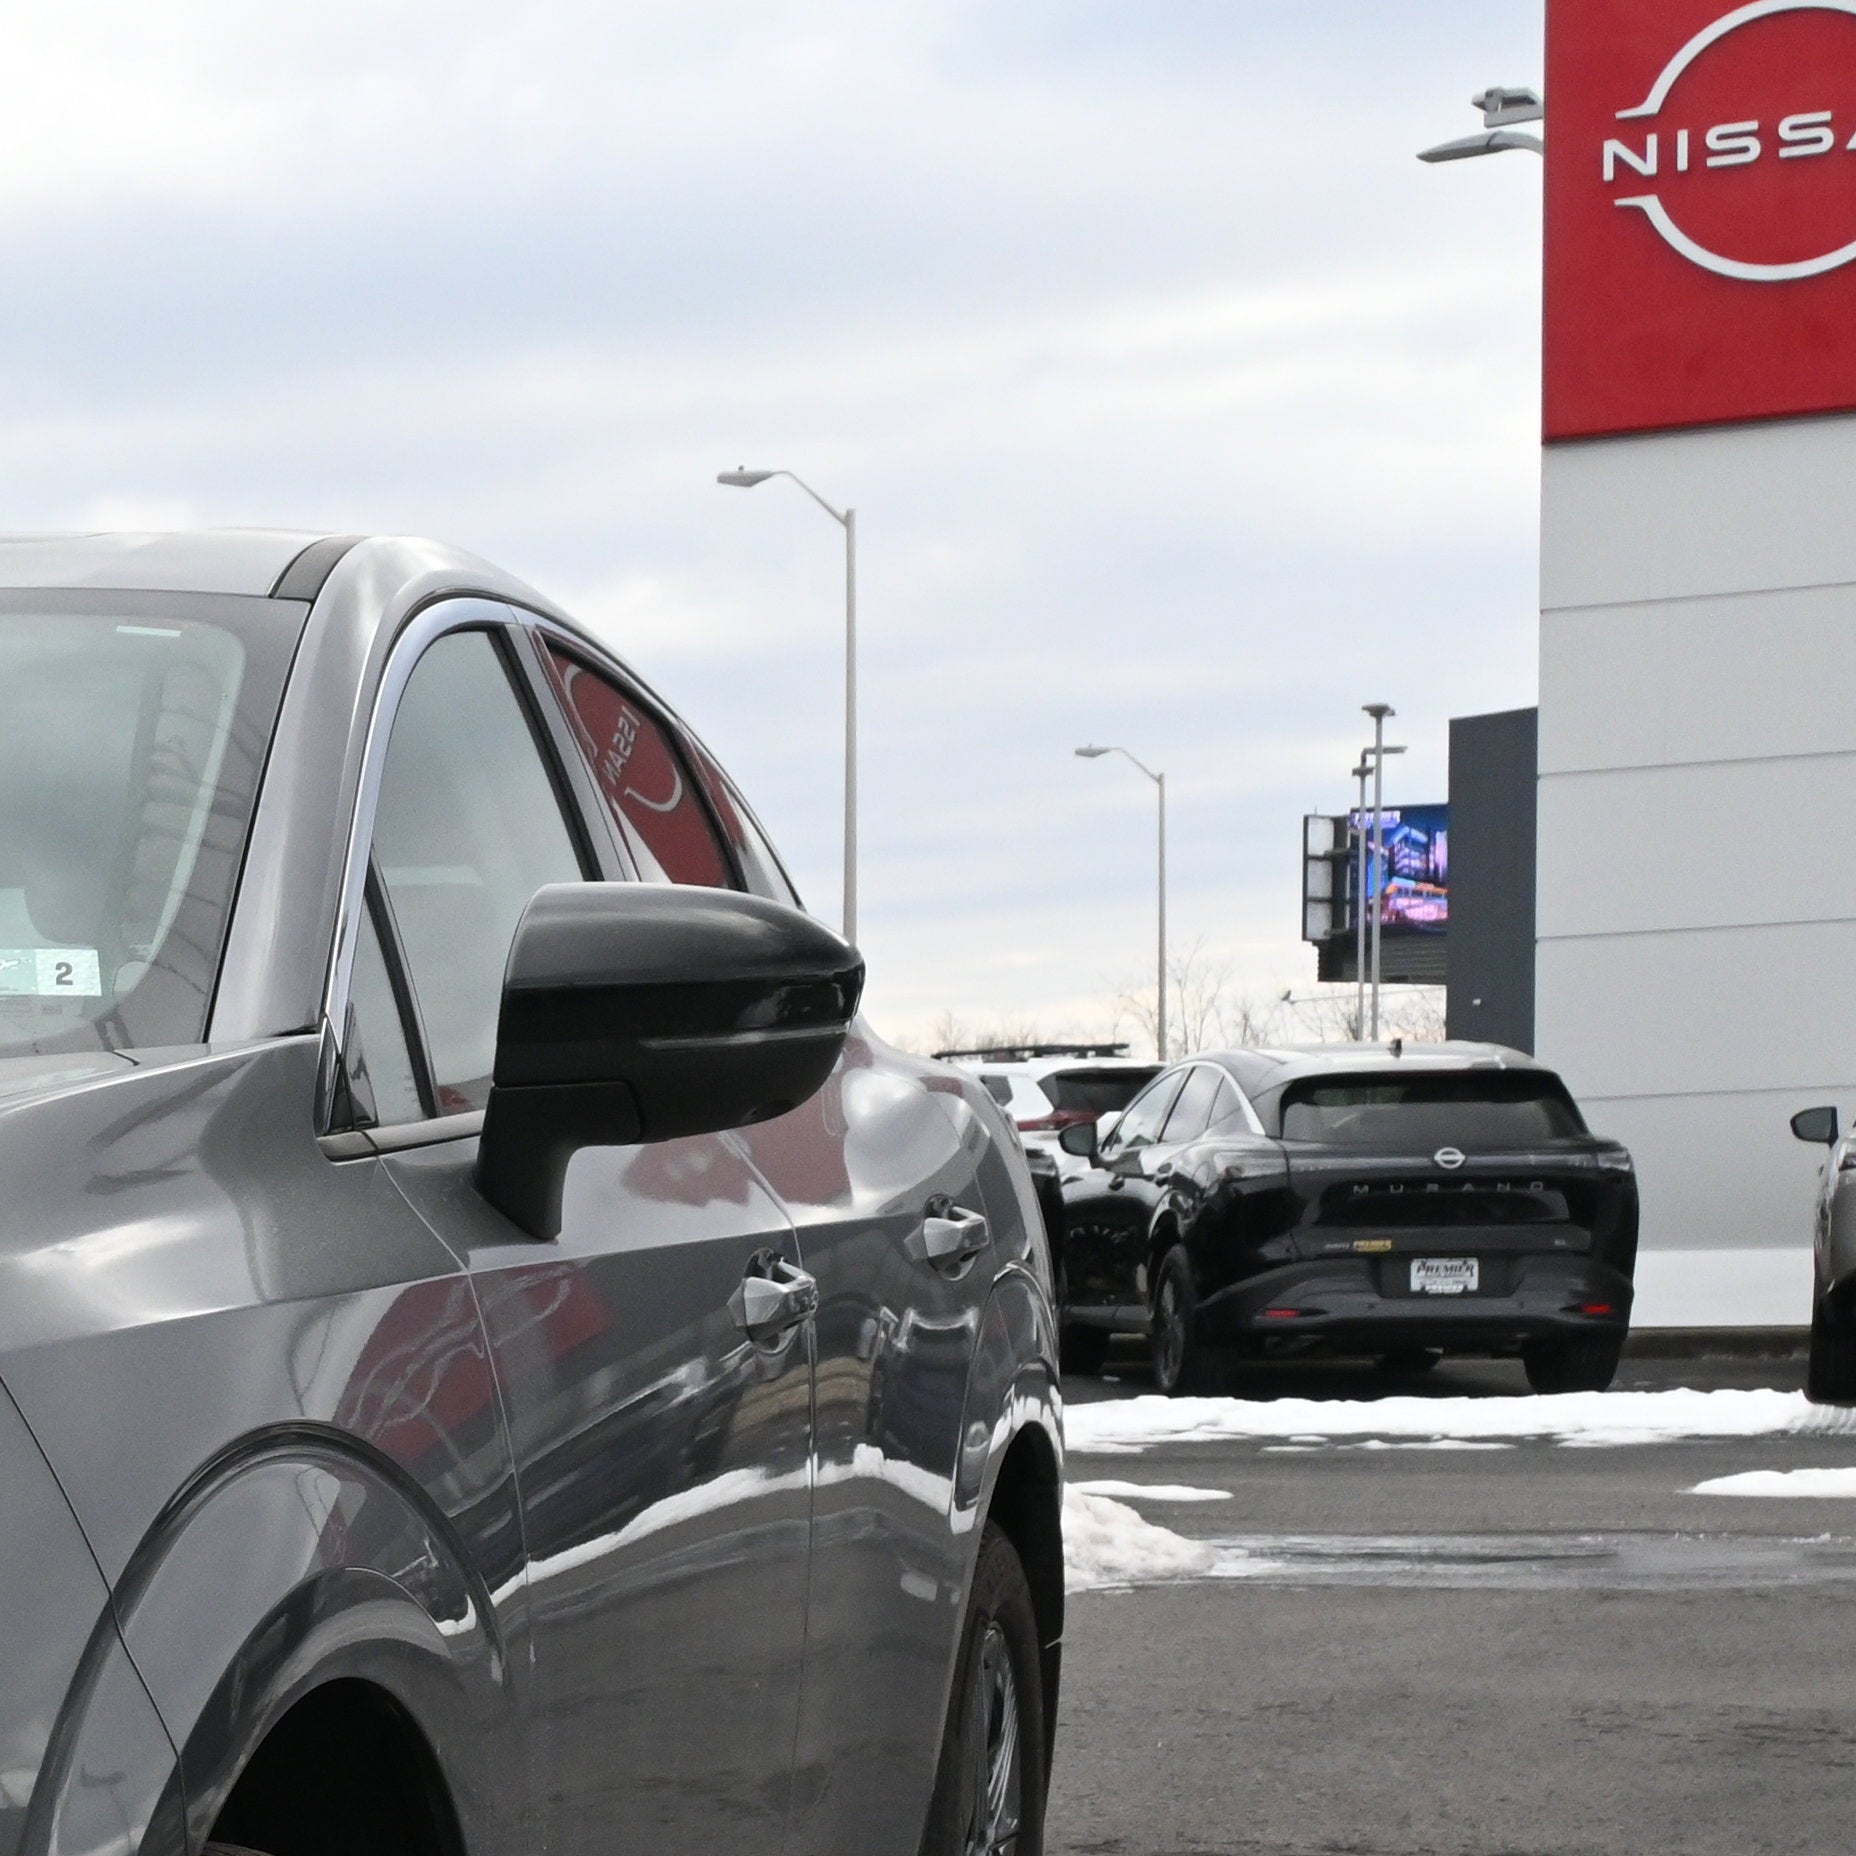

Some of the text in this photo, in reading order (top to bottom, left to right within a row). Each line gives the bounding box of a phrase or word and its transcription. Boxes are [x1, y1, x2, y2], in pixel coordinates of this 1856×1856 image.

[1603, 111, 1856, 181] NISS
[54, 962, 74, 986] 2
[1352, 1182, 1544, 1193] MURANO
